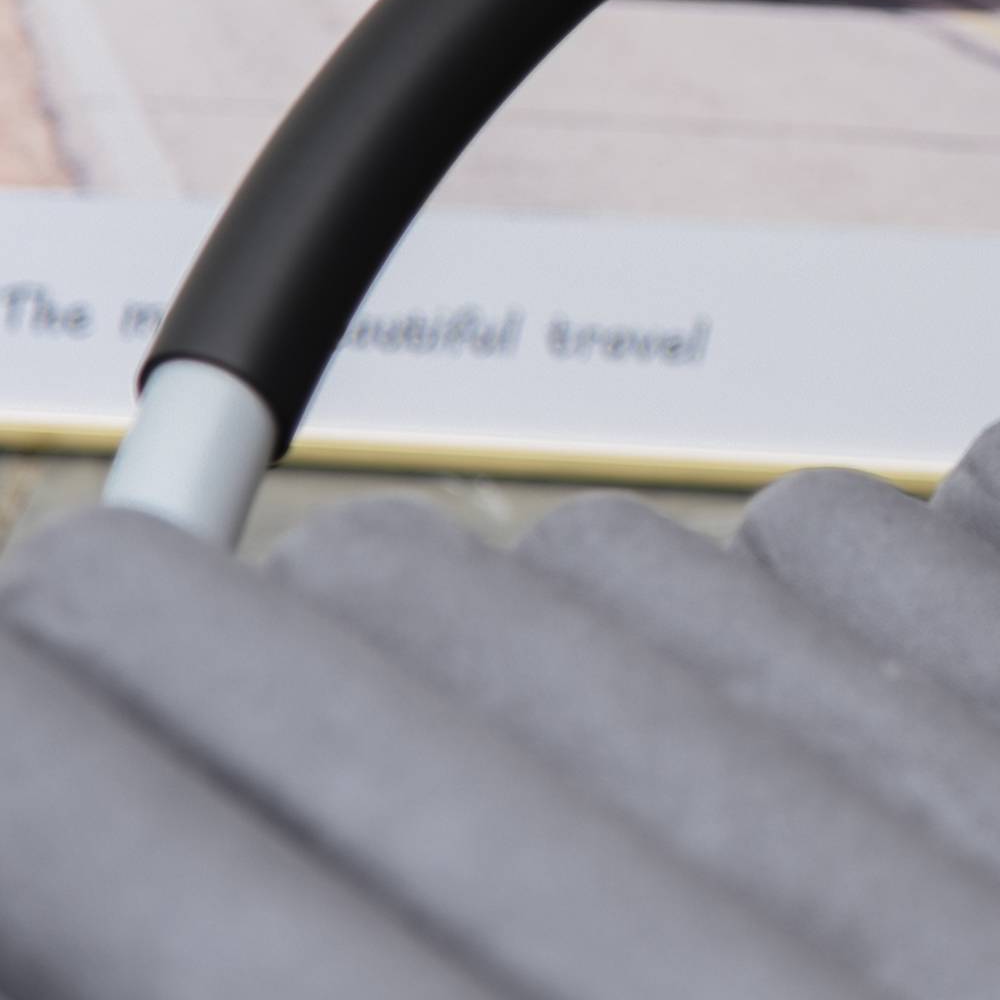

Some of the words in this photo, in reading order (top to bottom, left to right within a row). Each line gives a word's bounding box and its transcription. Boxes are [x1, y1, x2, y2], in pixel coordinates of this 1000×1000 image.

[3, 283, 94, 336] The
[343, 304, 522, 358] autiful
[546, 312, 712, 366] travel
